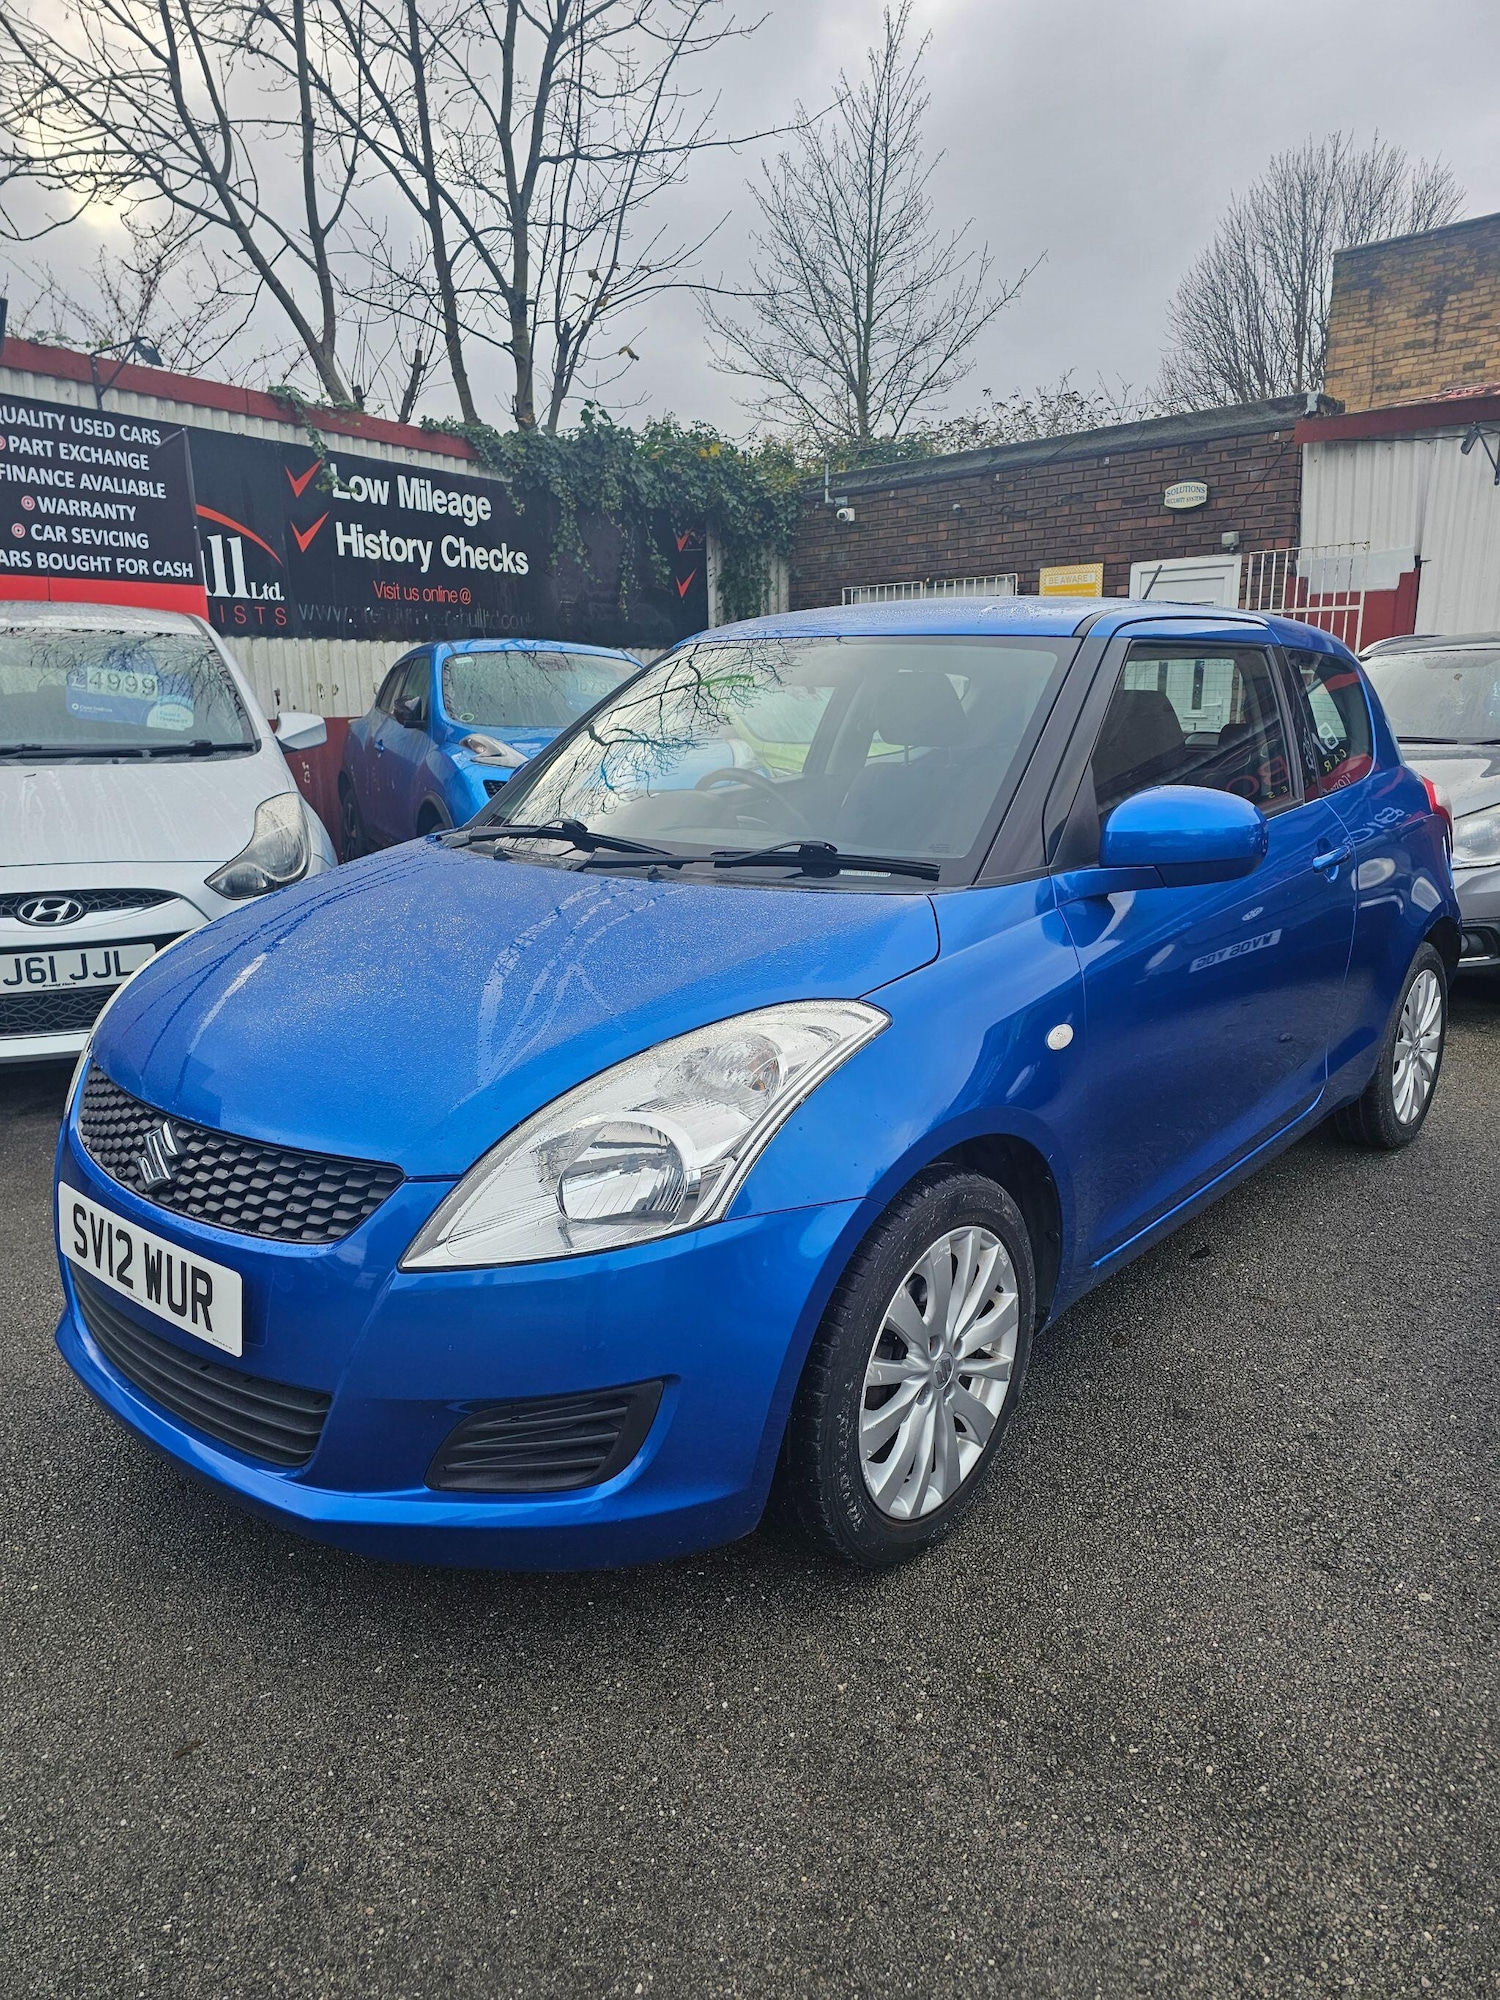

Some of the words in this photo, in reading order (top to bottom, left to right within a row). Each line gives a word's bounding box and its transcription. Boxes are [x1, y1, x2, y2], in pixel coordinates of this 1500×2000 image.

[70, 416, 116, 439] USED
[120, 424, 162, 446] CARS
[8, 435, 54, 458] PART
[59, 442, 150, 471] EXCHANGE
[80, 473, 167, 499] AVALIABLE
[330, 462, 390, 506] Low
[397, 474, 492, 527] Mileage
[1166, 485, 1206, 498] SOLUTIONS
[36, 495, 137, 522] WARRANTY
[30, 523, 68, 543] CAR
[71, 527, 150, 550] SEVICING
[335, 521, 433, 573] History
[441, 534, 529, 575] Checks
[36, 552, 112, 573] BOUGHT
[116, 558, 150, 576] FOR
[152, 560, 194, 578] CASH
[250, 582, 285, 601] Ltd.
[373, 580, 401, 600] Visit
[404, 587, 419, 602] us
[422, 585, 458, 603] online
[3, 954, 58, 986] J61
[69, 950, 135, 981] JJL
[73, 1202, 134, 1290] SV12
[144, 1242, 213, 1333] WUR
